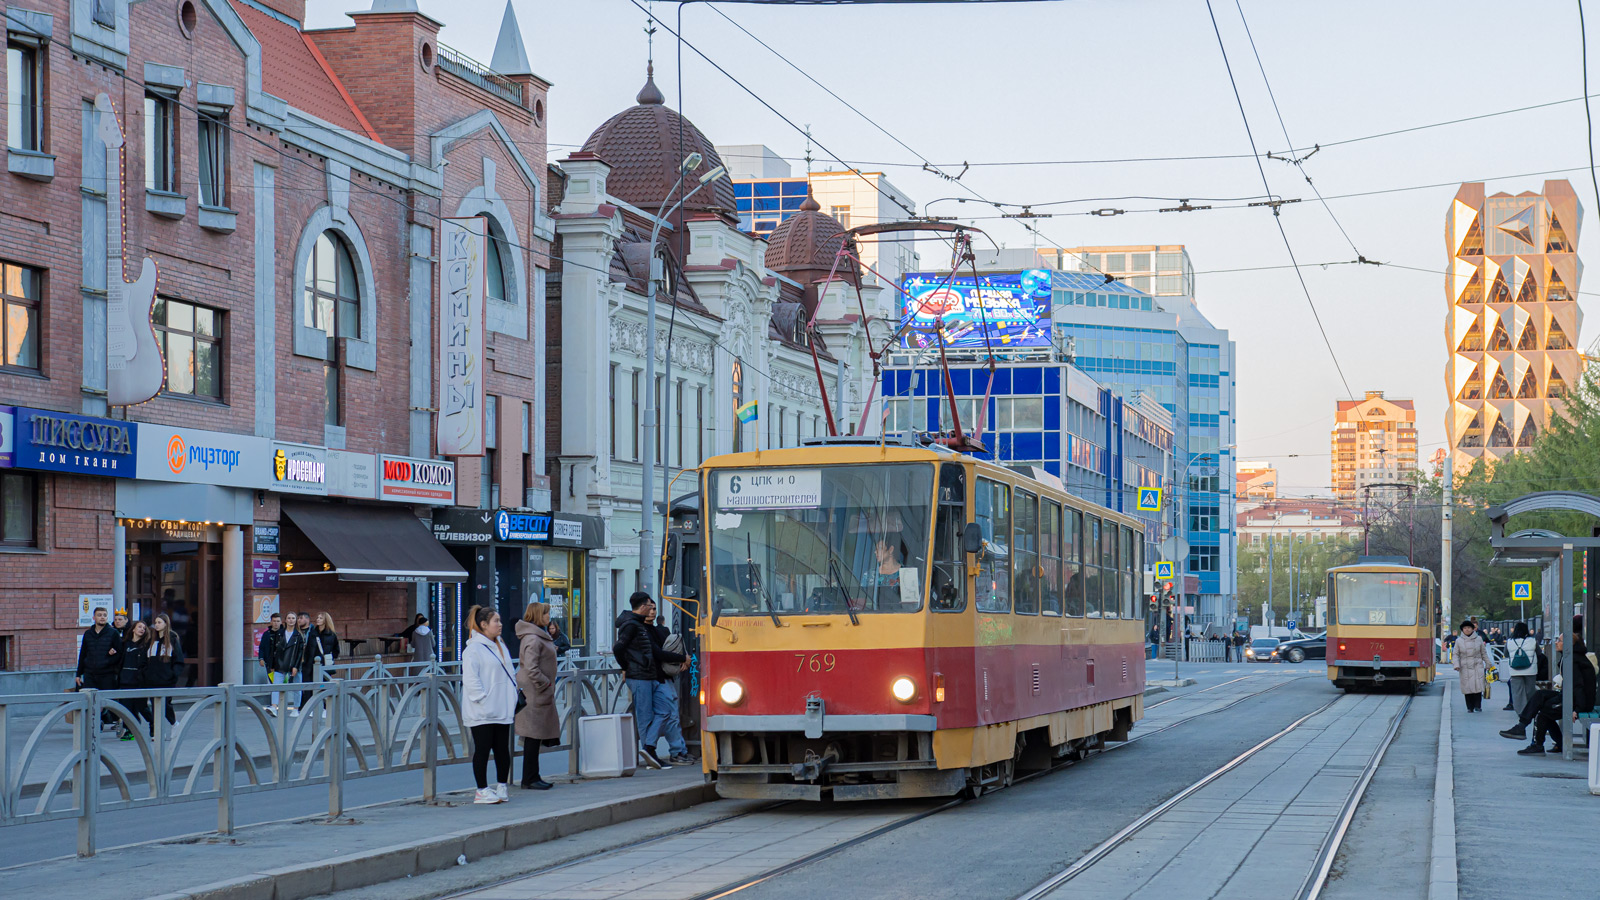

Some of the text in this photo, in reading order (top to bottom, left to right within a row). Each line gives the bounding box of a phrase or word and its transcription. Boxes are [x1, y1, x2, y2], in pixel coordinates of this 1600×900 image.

[31, 414, 132, 454] ТИССУРА
[383, 460, 453, 485] MOD KOMOD
[730, 475, 742, 494] 6
[751, 475, 773, 487] ЦПК
[433, 524, 450, 532] БАР
[509, 514, 551, 532] BETCITY
[433, 531, 492, 542] ТЕЛЕВИЗОР
[1370, 611, 1385, 623] 32
[1369, 642, 1385, 651] 776
[794, 652, 836, 673] 769
